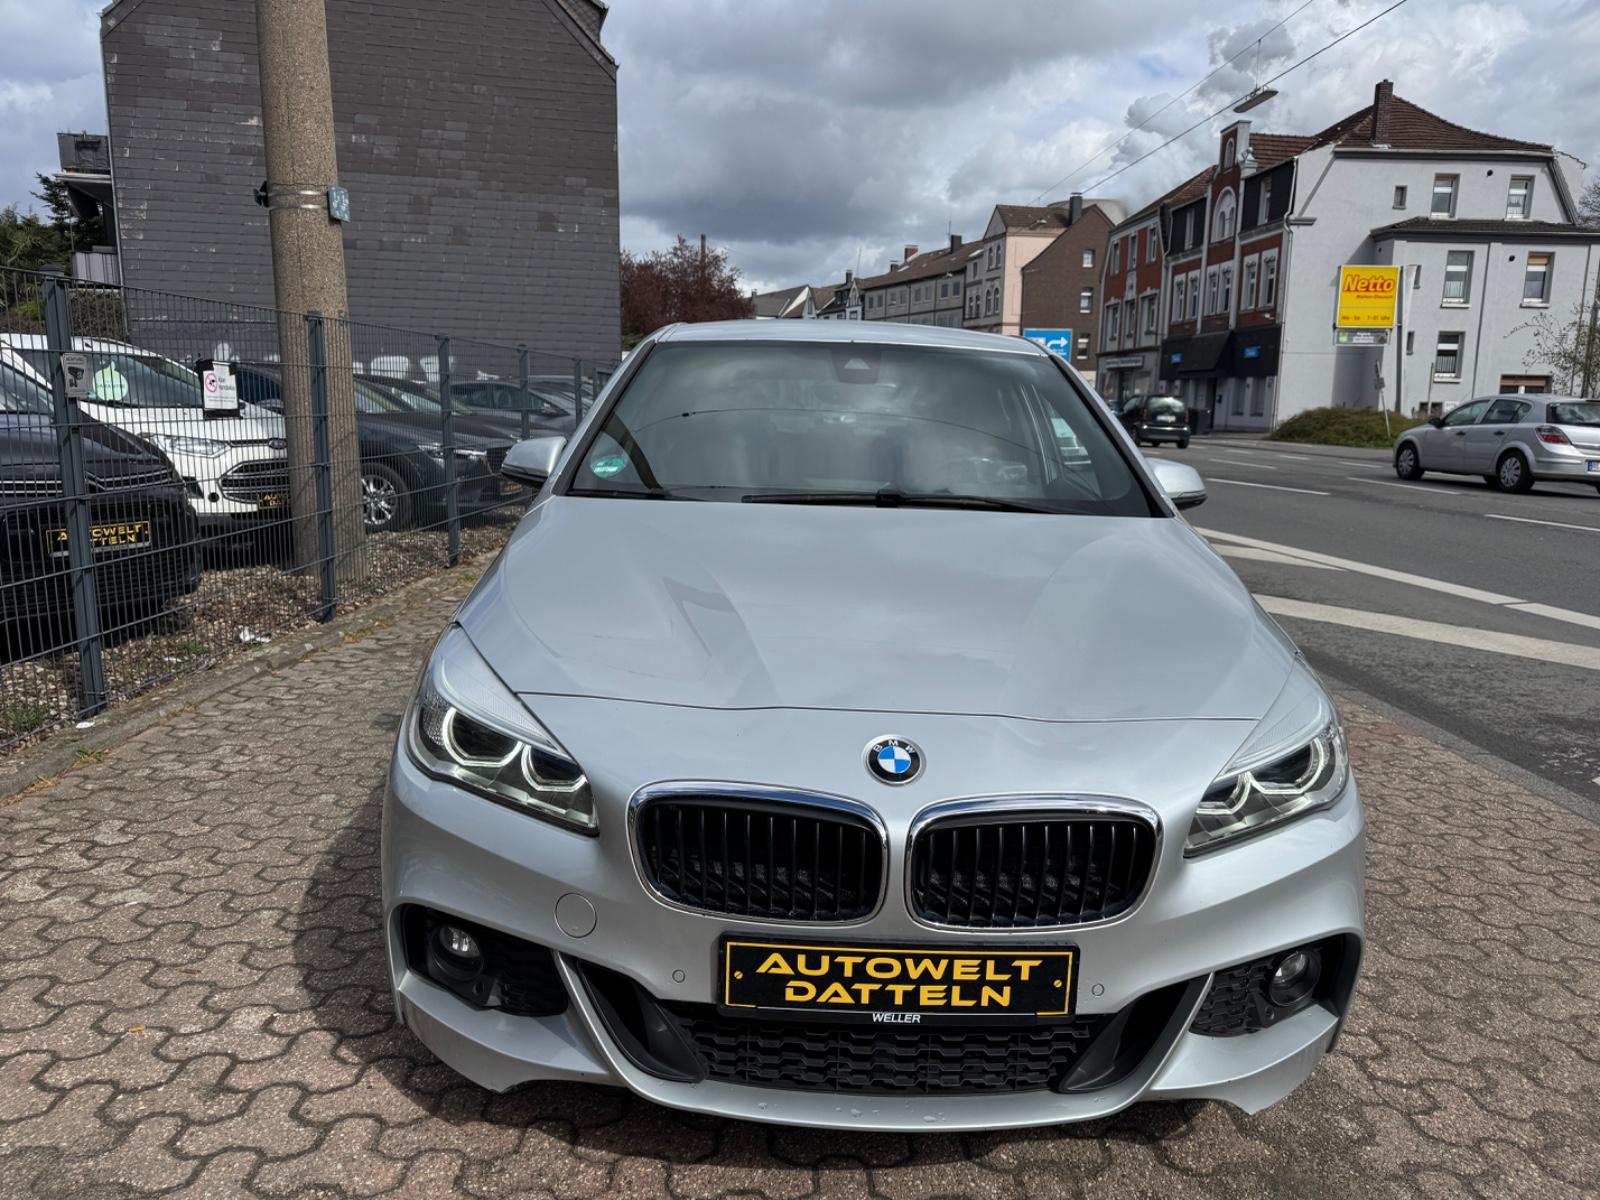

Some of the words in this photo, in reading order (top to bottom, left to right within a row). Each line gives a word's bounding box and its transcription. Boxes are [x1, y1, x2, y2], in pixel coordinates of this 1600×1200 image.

[1343, 274, 1395, 292] Netto
[57, 524, 142, 541] AOWELT
[872, 739, 916, 754] BMW
[755, 952, 1044, 982] AUTOWELT
[784, 980, 1012, 1007] DATTELN
[872, 1012, 922, 1024] WELLER
